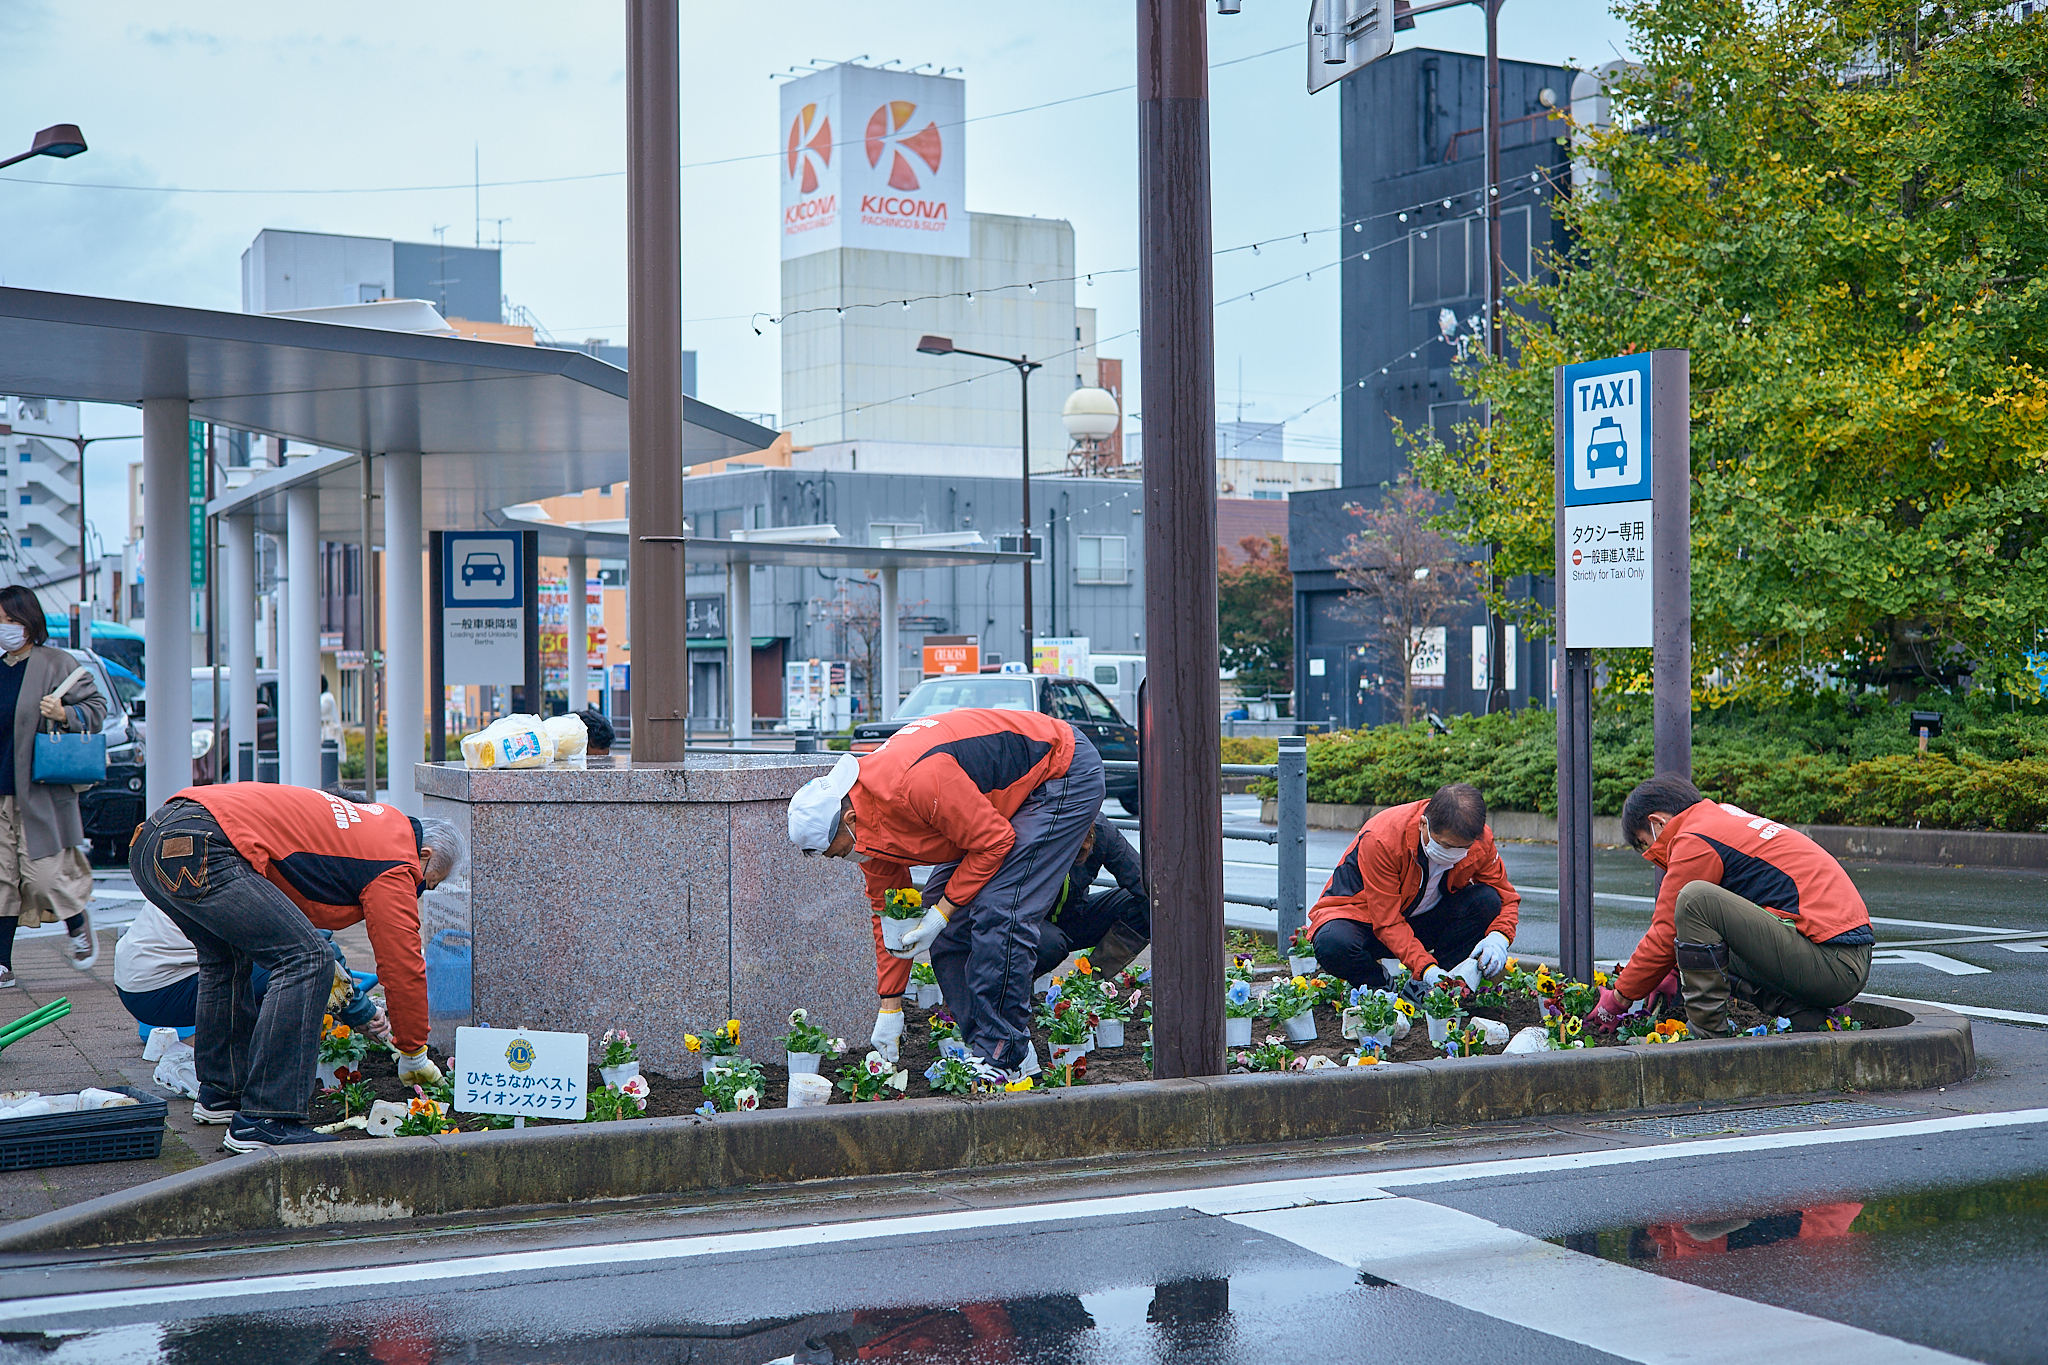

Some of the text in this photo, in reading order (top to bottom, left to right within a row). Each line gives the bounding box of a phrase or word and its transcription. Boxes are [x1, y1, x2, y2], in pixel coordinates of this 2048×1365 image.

[785, 194, 836, 225] KICONA
[861, 195, 948, 220] KICONA
[861, 215, 913, 229] PACHINCO
[921, 221, 946, 232] SLOT
[1579, 378, 1634, 412] TAXI
[1572, 521, 1644, 545] タクシー専用
[1583, 546, 1645, 565] 一般車進入禁止
[1572, 567, 1645, 583] Strictly for Taxi Only
[450, 618, 518, 630] 一般車乗降場
[450, 631, 475, 639] Loading
[488, 631, 518, 639] Unloading
[330, 802, 350, 830] CLUB
[511, 1039, 531, 1048] LIONS
[517, 1049, 525, 1061] L
[467, 1071, 577, 1092] ひたちなかベスト
[467, 1089, 578, 1110] ライオンズクラブ
